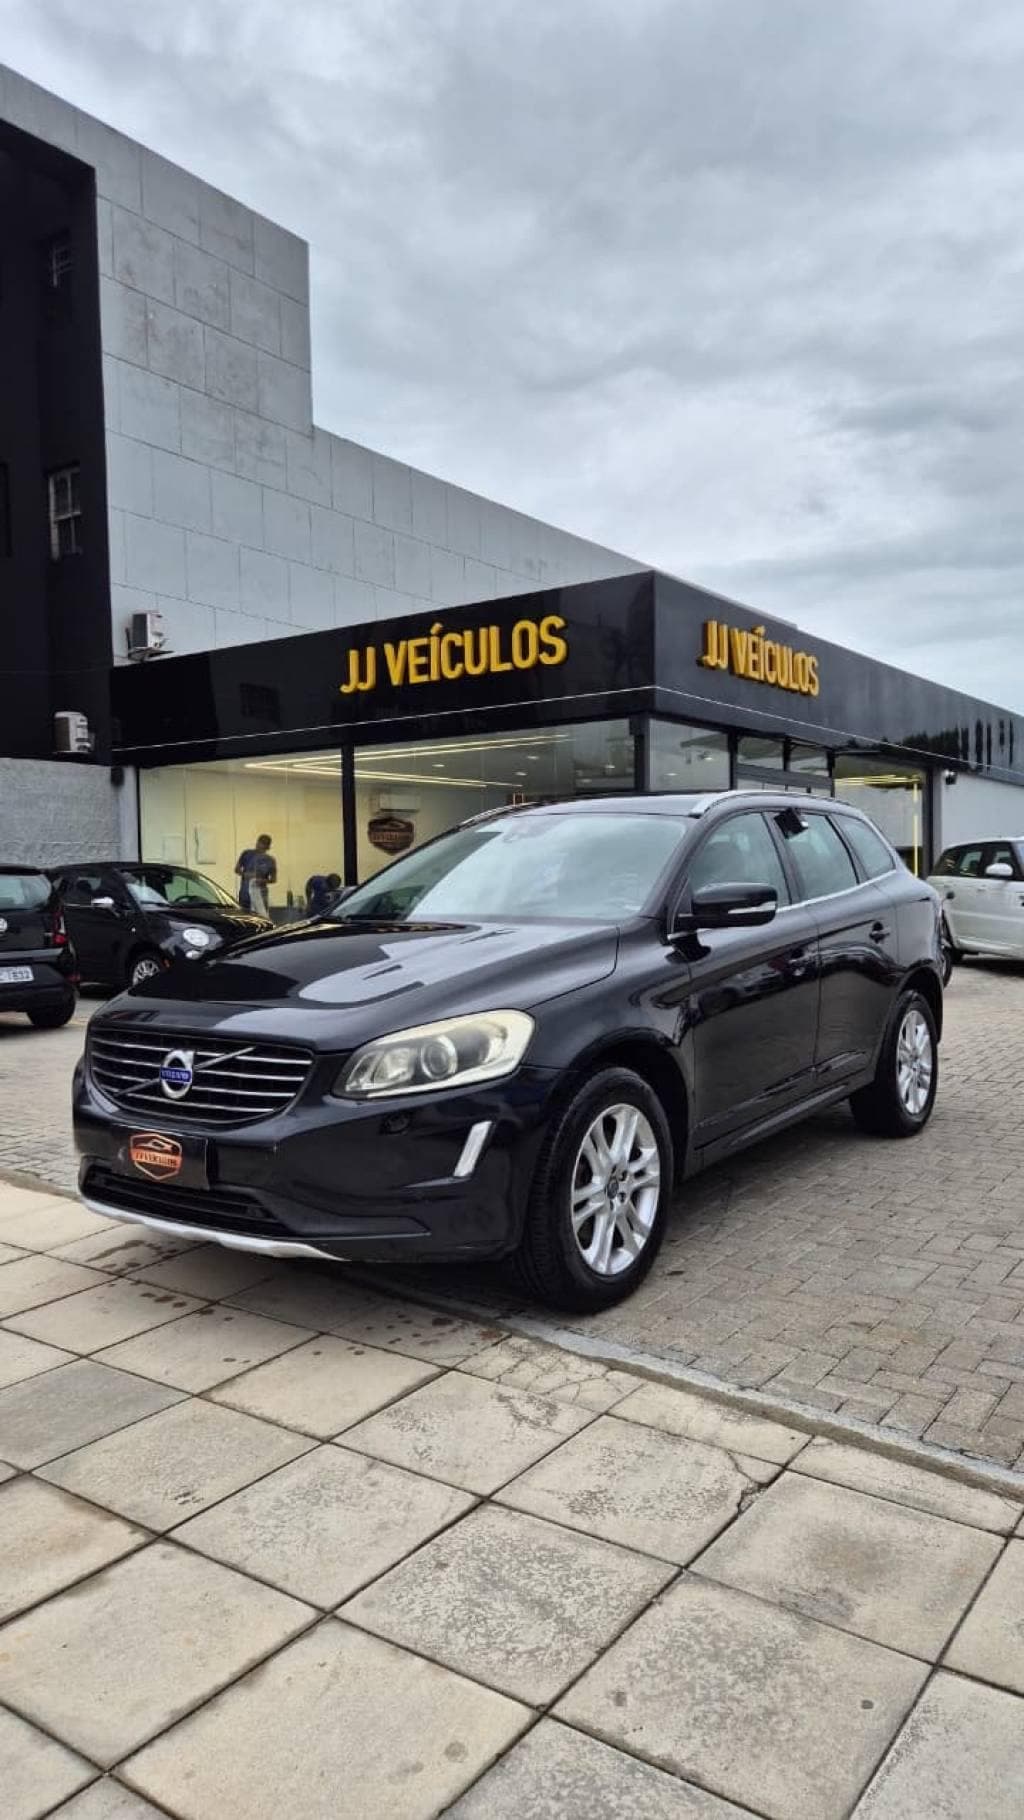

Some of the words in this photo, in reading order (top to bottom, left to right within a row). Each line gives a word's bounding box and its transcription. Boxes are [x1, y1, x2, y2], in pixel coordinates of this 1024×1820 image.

[340, 646, 376, 693] JJ
[384, 615, 568, 686] VEÍCULOS
[701, 620, 729, 670] JJ
[730, 625, 819, 696] VEÍCULOS
